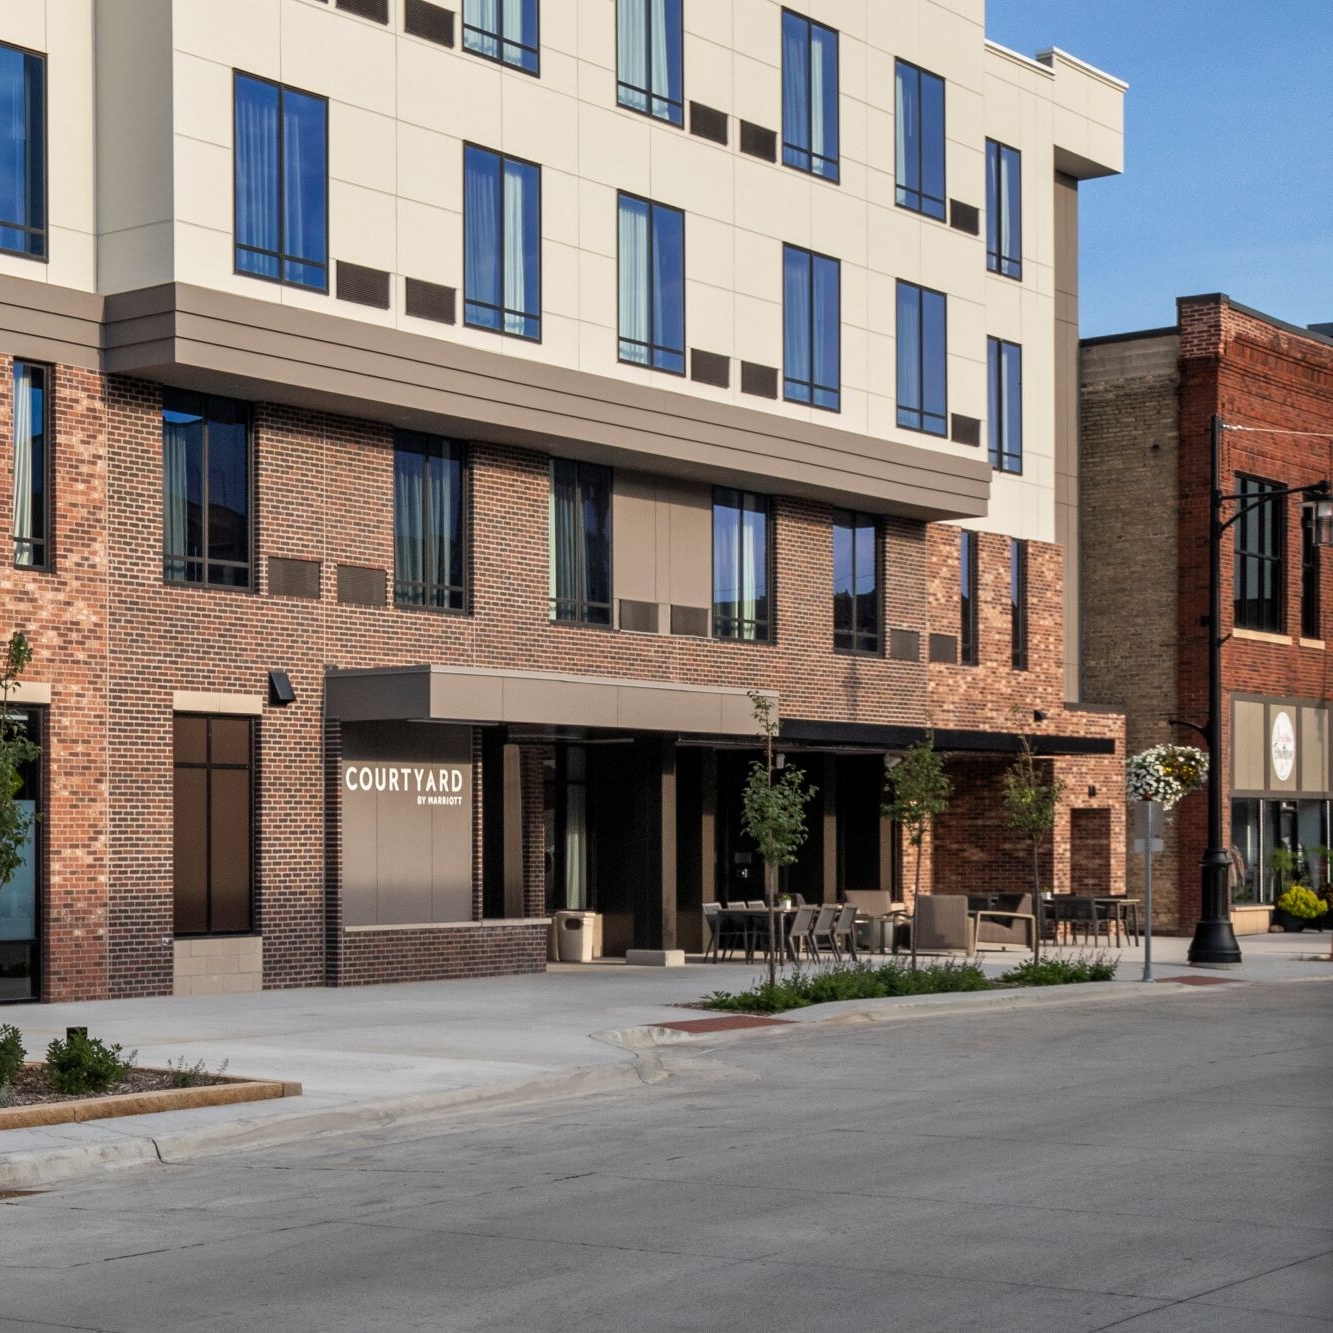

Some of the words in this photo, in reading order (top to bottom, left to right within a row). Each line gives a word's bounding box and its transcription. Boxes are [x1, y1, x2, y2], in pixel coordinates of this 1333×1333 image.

[345, 766, 463, 792] COURTYARD
[417, 796, 427, 805] BY
[428, 796, 462, 805] MARRIOTT
